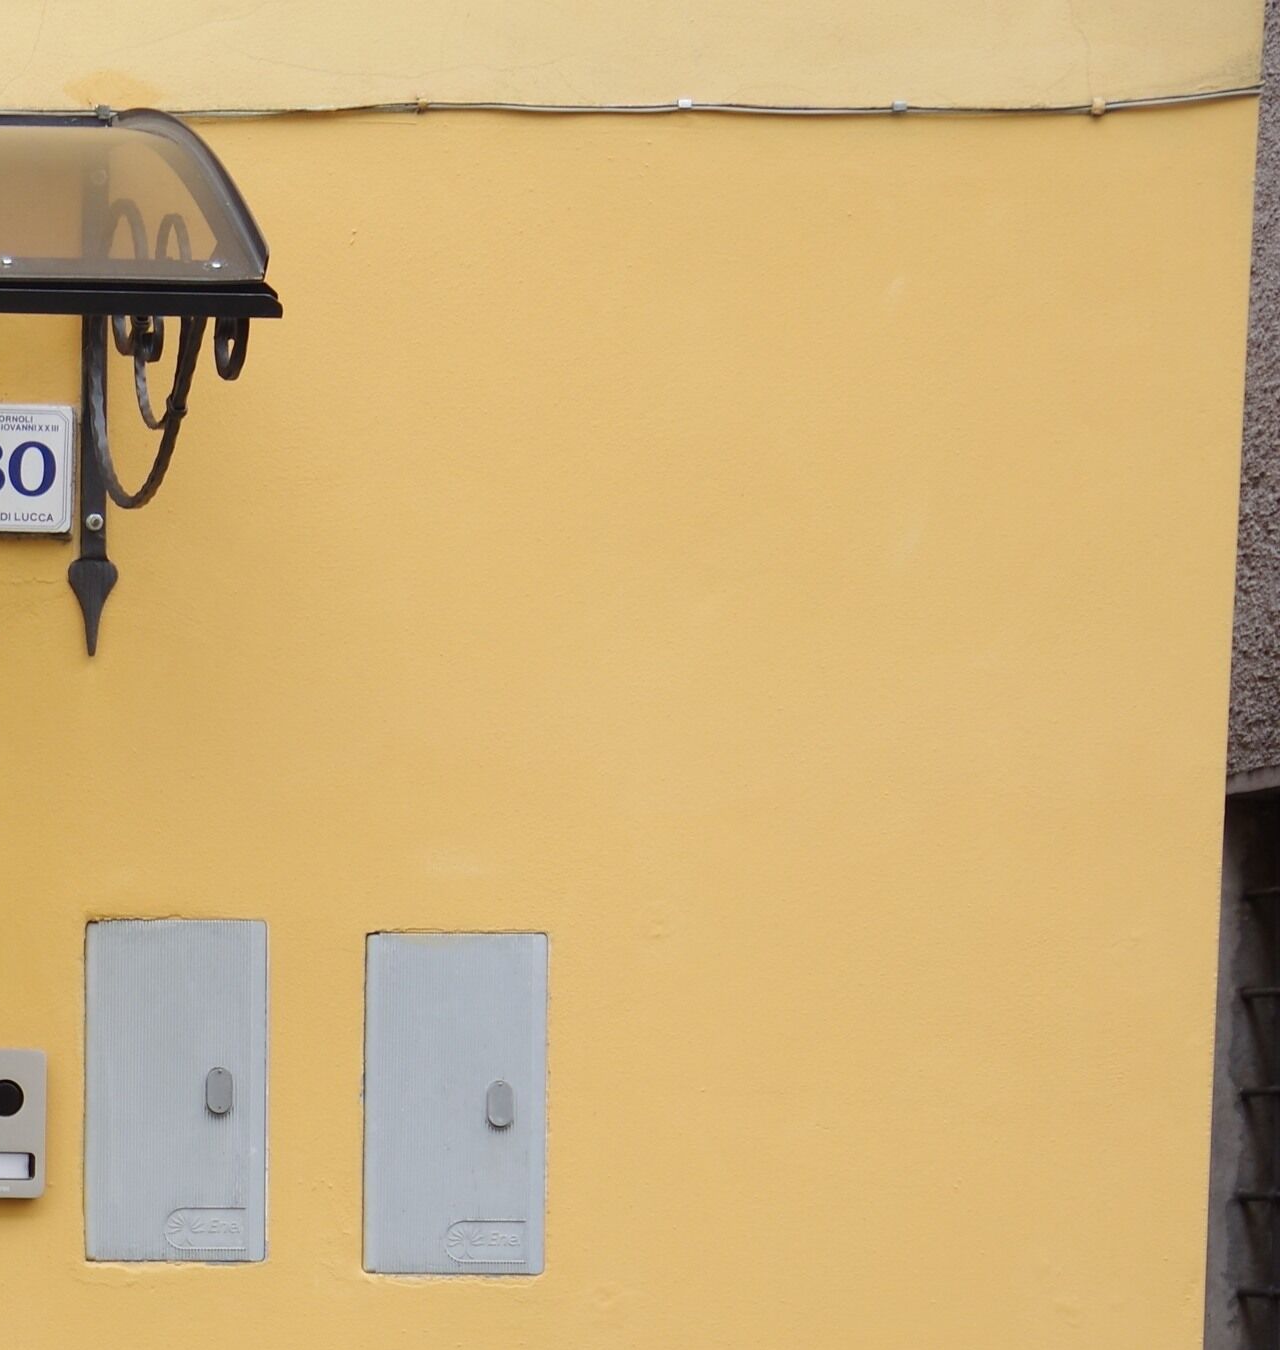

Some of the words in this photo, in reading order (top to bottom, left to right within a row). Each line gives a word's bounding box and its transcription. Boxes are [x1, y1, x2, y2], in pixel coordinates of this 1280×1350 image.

[0, 512, 11, 521] DI
[14, 512, 54, 522] LUCCA
[486, 1230, 523, 1247] Ene
